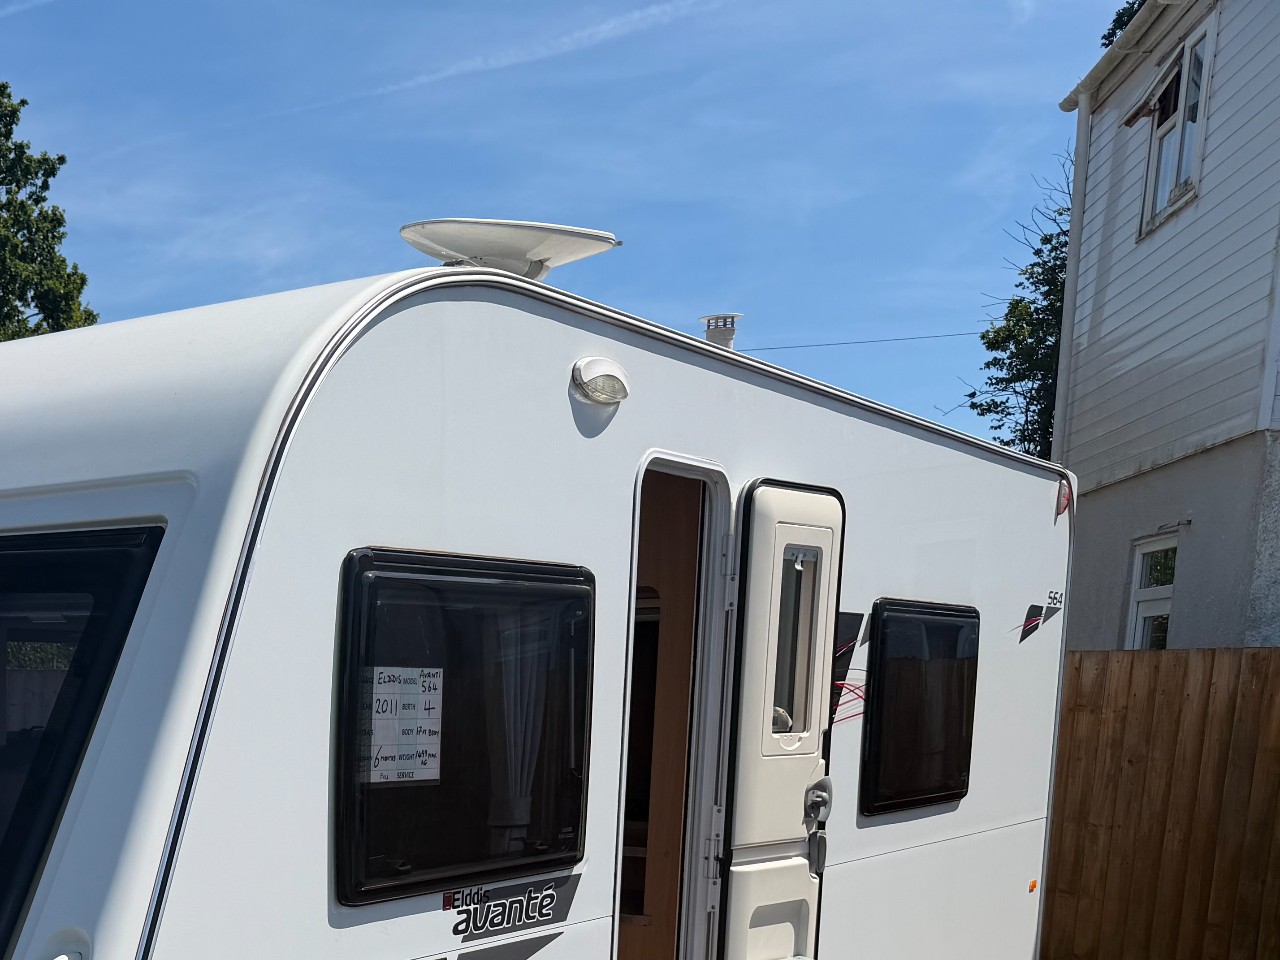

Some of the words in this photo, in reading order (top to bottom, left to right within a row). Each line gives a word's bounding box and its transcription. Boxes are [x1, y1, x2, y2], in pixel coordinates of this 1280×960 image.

[1047, 590, 1064, 606] 564
[402, 677, 418, 685] MODEL
[421, 680, 438, 693] 564
[375, 698, 398, 716] 2011
[402, 703, 416, 711] BERTH
[423, 699, 436, 717] 4
[401, 728, 415, 736] BODY
[373, 745, 383, 768] 6
[396, 771, 415, 779] SERVICE
[451, 886, 491, 909] Elddis
[452, 882, 557, 936] avanté
